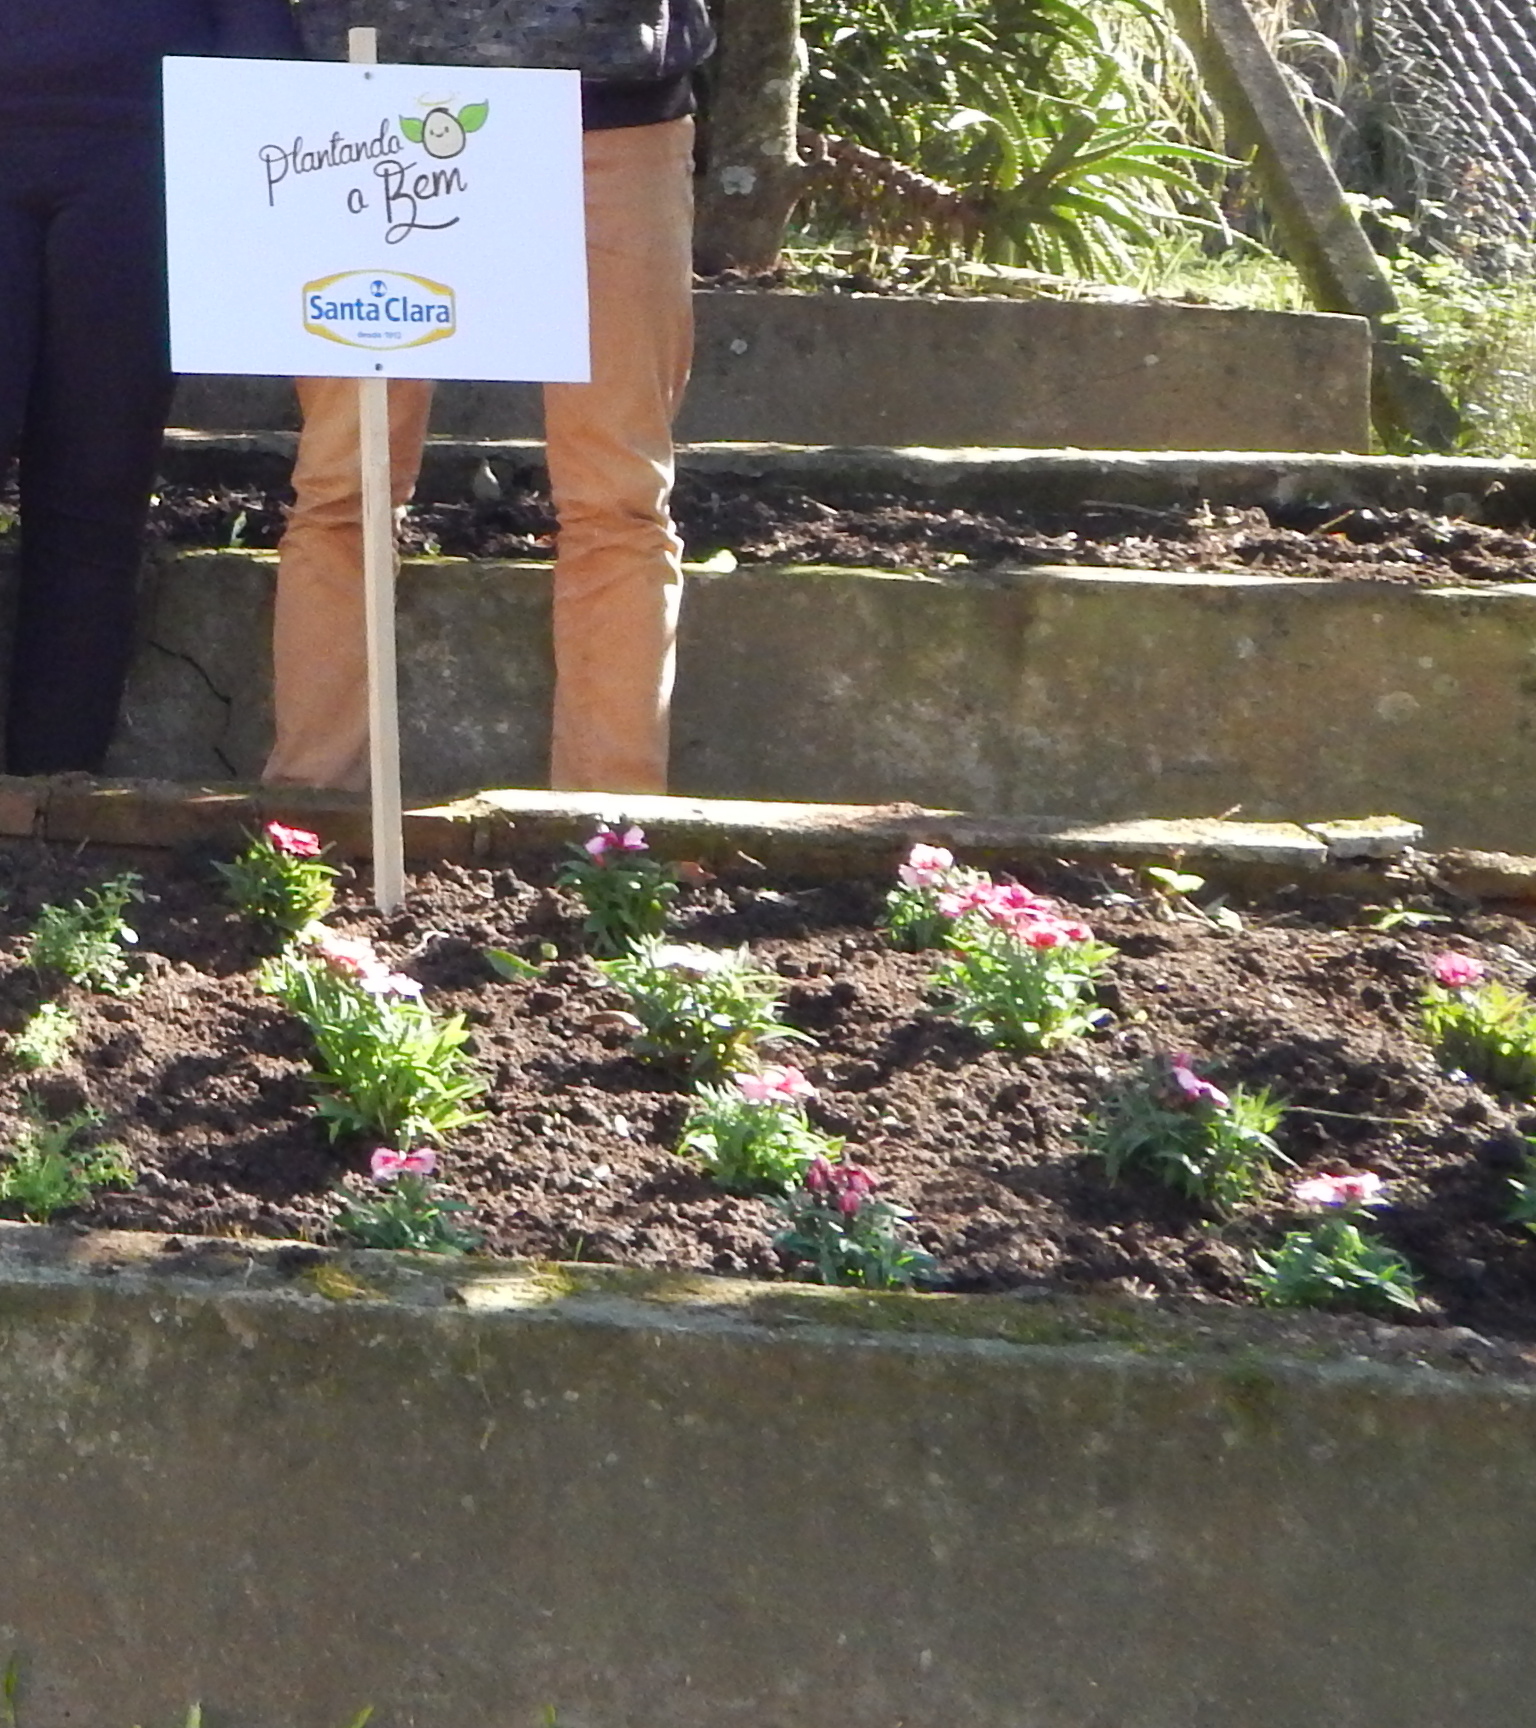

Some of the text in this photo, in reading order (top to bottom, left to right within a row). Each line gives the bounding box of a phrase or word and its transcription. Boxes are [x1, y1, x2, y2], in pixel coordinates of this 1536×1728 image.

[259, 118, 404, 206] Plantando
[373, 159, 467, 244] Bem
[310, 295, 450, 323] Santa Clara
